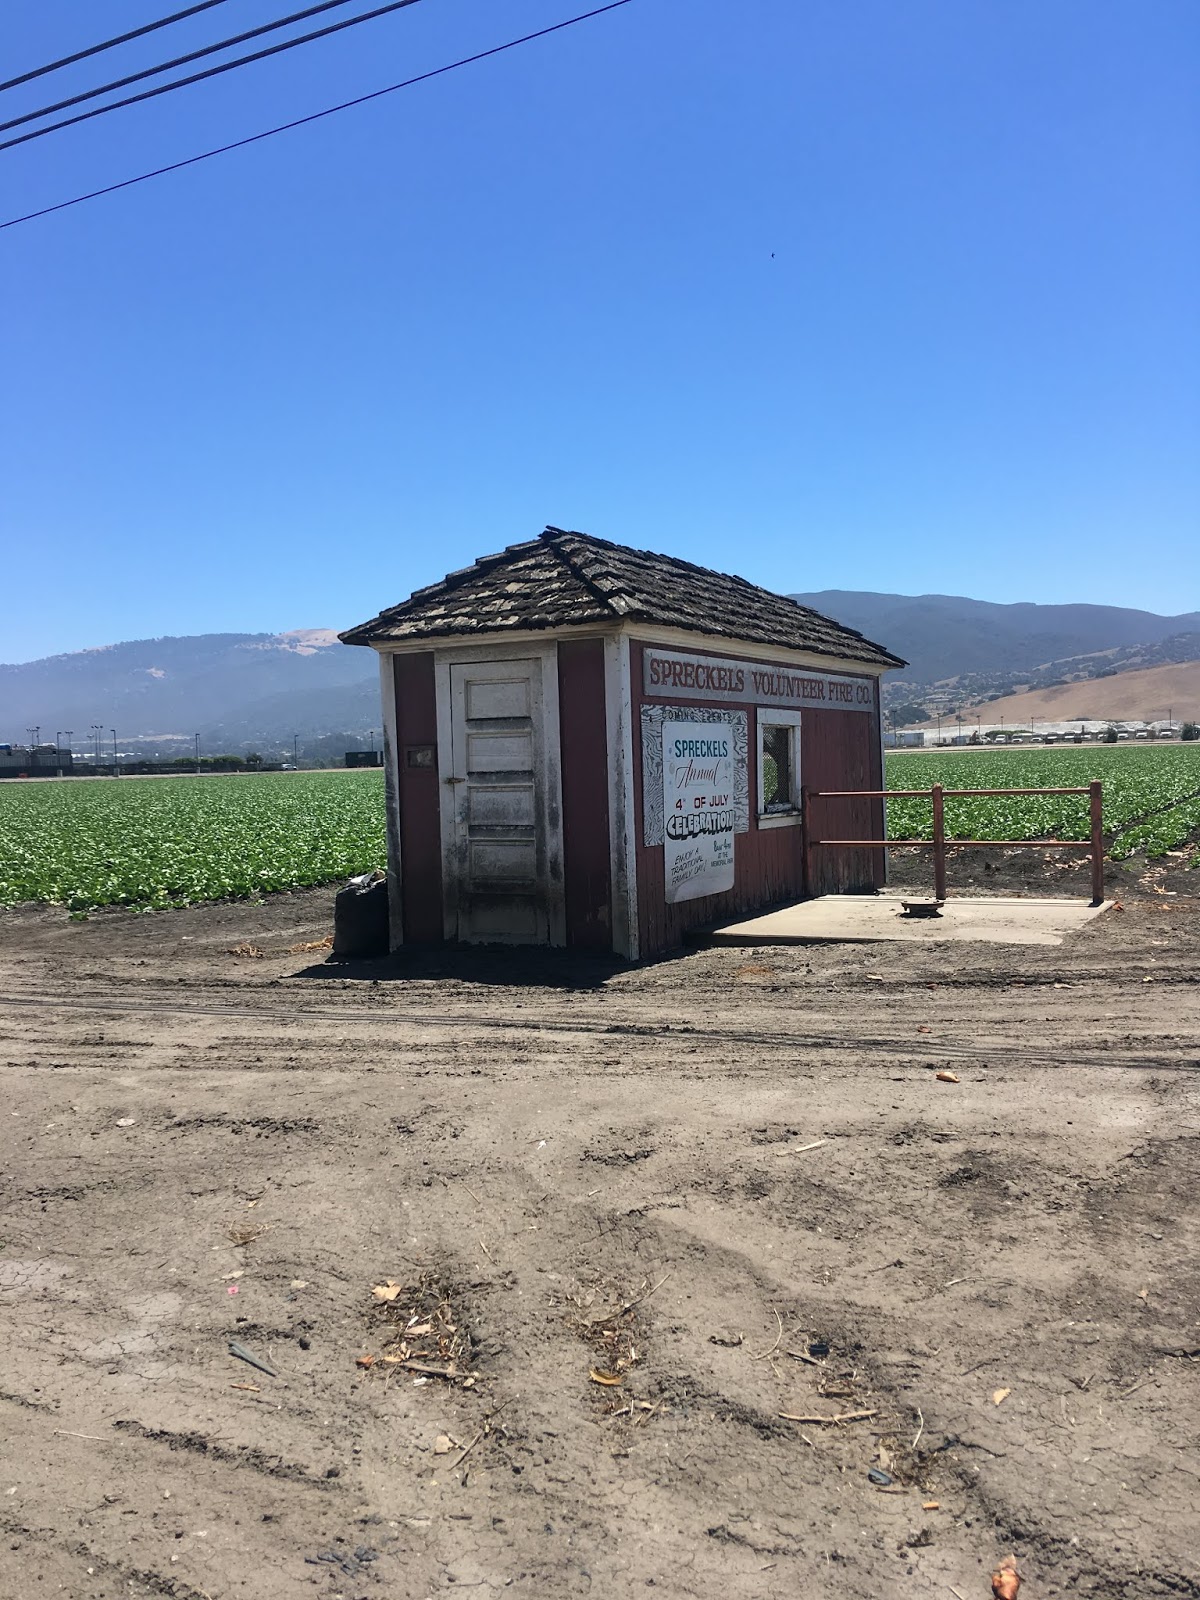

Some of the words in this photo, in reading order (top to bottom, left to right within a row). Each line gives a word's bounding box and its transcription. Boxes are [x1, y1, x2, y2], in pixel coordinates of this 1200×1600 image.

[649, 658, 745, 692] SPRECKELS
[751, 671, 825, 700] VOLUNTEER
[828, 680, 853, 702] FIRE
[856, 685, 872, 704] CO.
[674, 739, 728, 758] SPRECKELS
[675, 758, 729, 789] Annual
[694, 796, 706, 809] OF
[709, 794, 729, 807] JULY
[666, 809, 736, 840] CELEBRATION
[671, 856, 703, 876] TRADITIONAL
[675, 849, 694, 865] ENJOY
[672, 869, 693, 886] FAMILY
